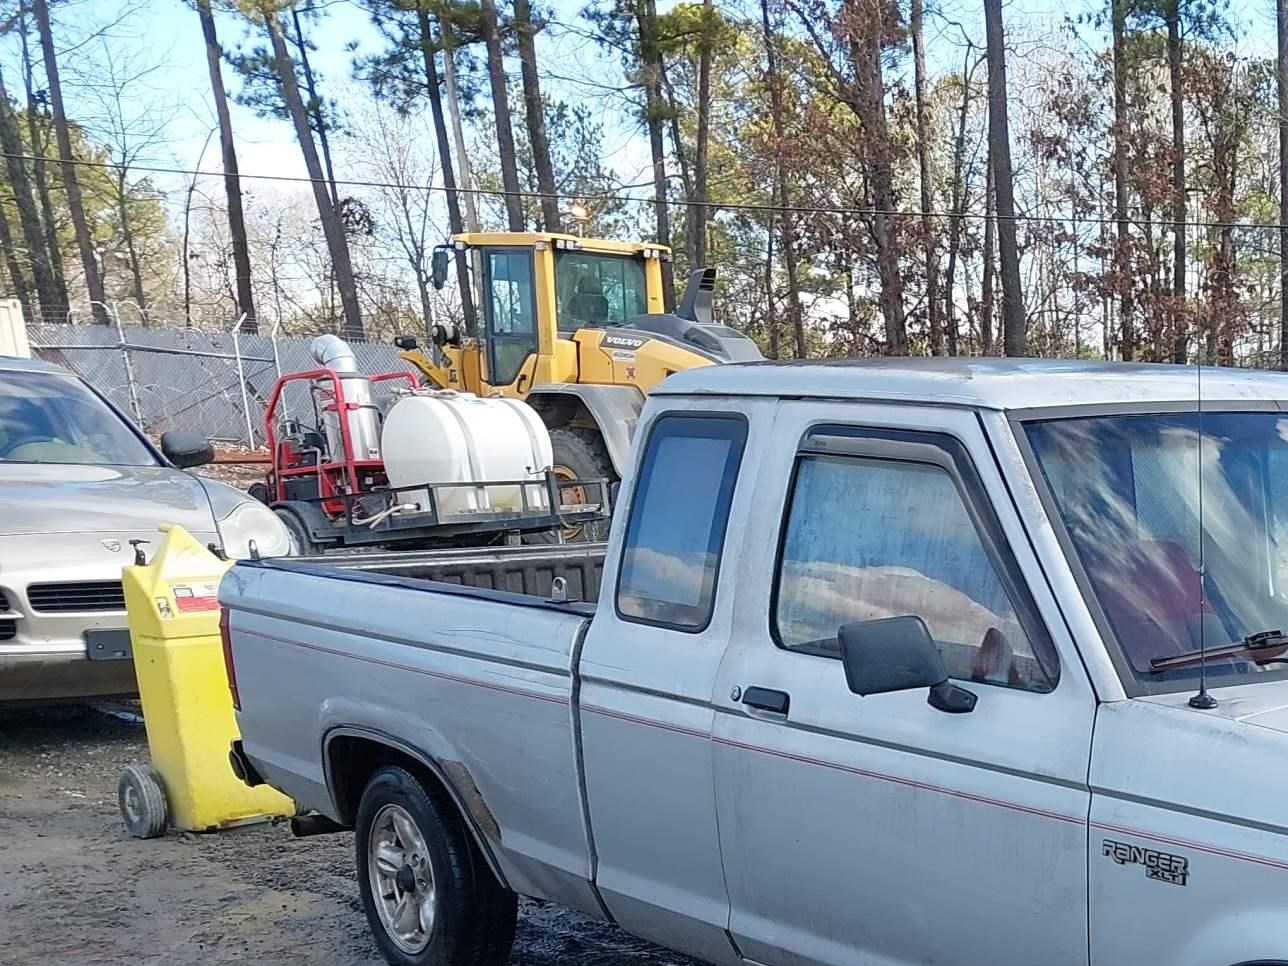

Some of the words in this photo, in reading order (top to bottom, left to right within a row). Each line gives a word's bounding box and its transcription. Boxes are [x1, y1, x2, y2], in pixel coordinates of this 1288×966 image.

[606, 336, 642, 347] VOLVO
[1102, 838, 1190, 876] RANGER
[1149, 867, 1180, 883] XLT
